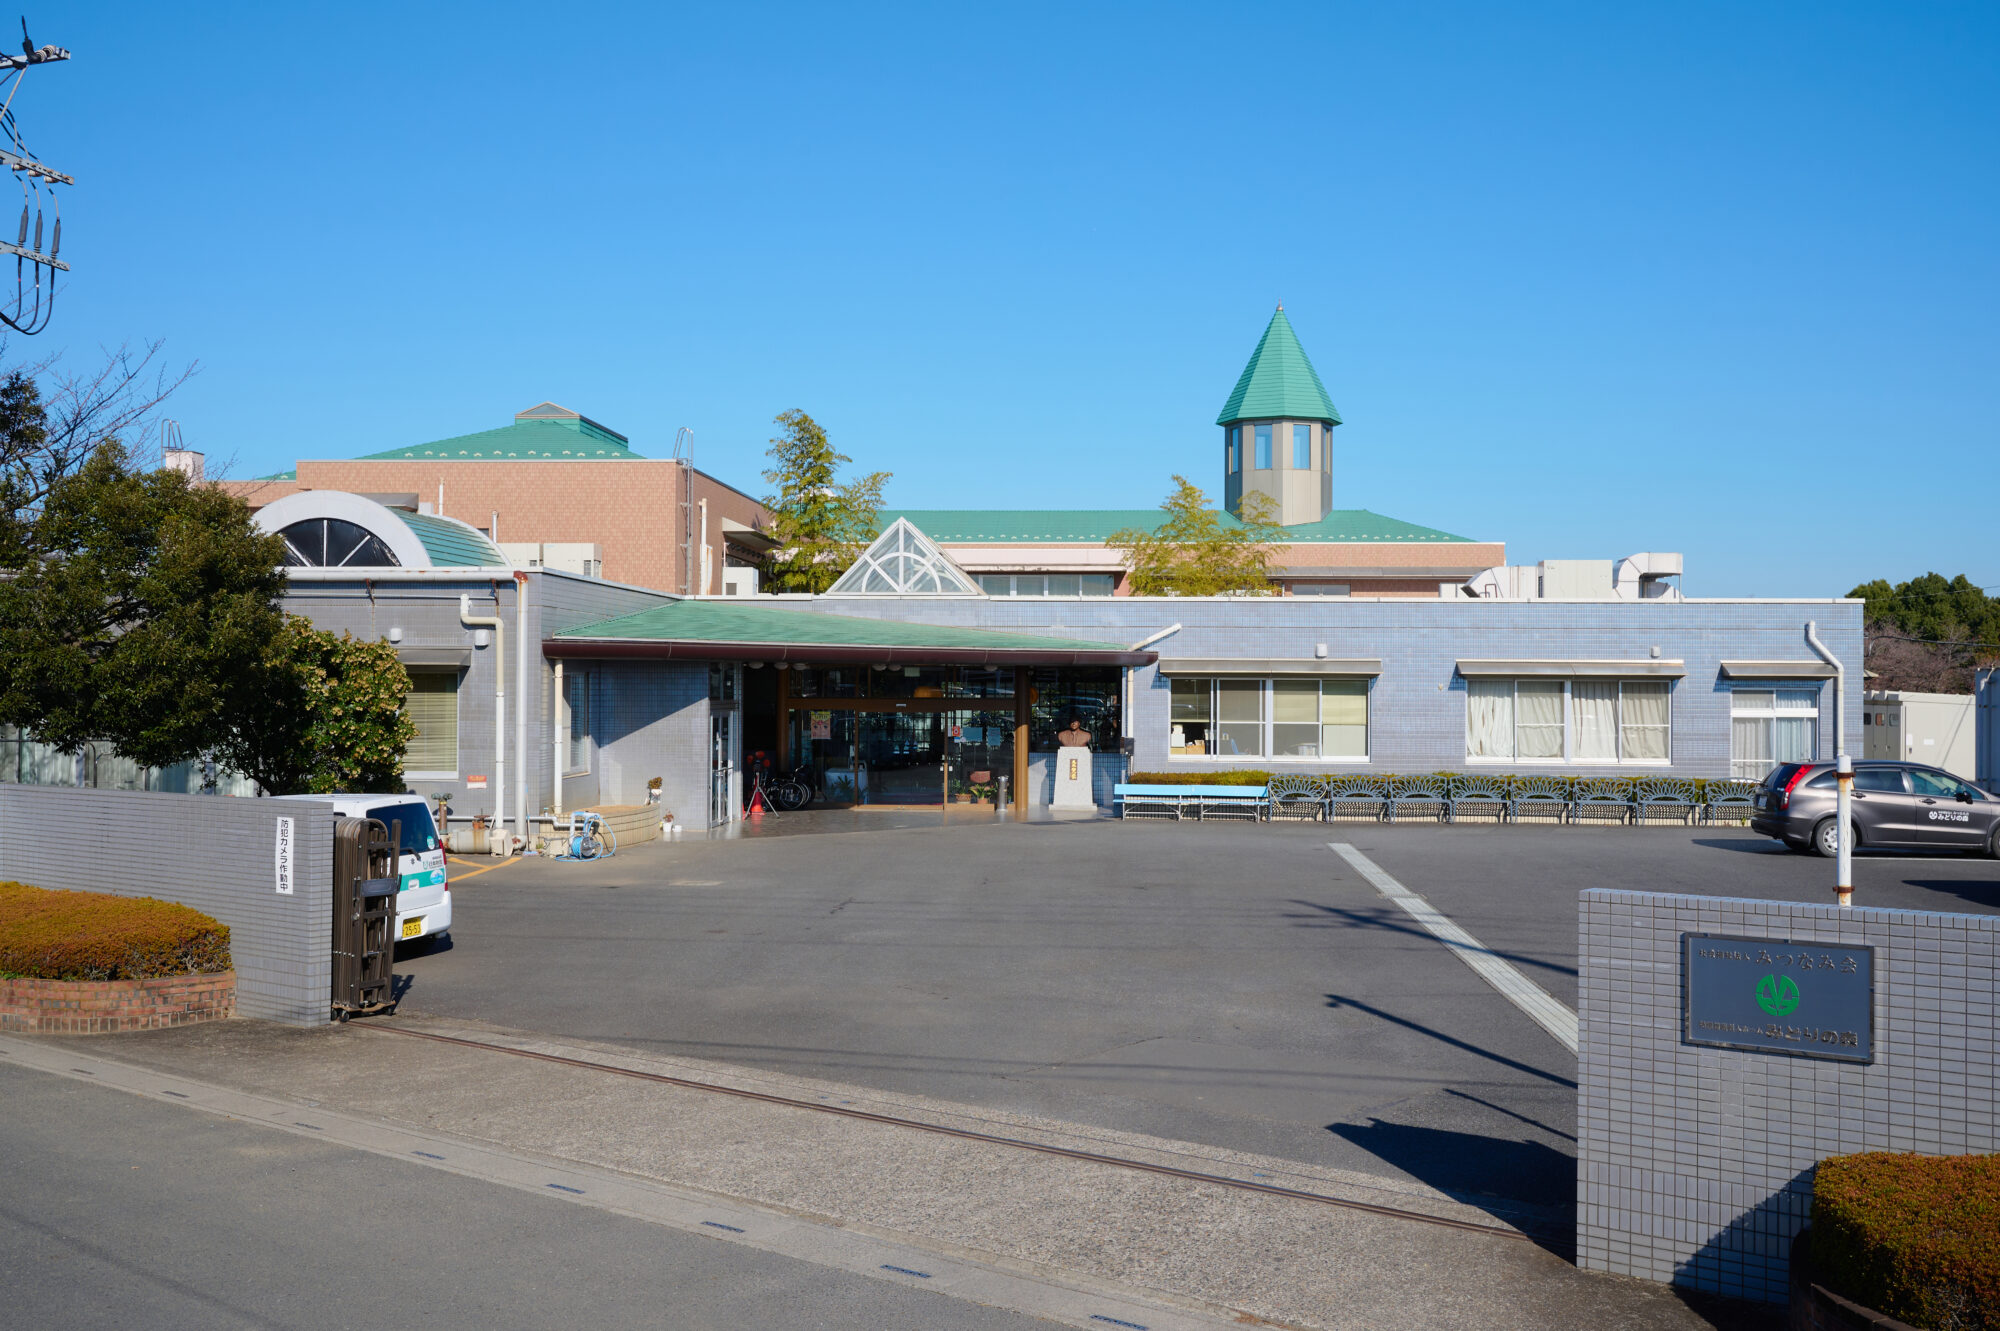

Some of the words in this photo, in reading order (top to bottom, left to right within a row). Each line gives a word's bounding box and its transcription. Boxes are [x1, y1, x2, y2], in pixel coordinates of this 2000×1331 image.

[279, 819, 289, 892] 防犯カメラ作動中
[1755, 949, 1857, 974] みつなみ会
